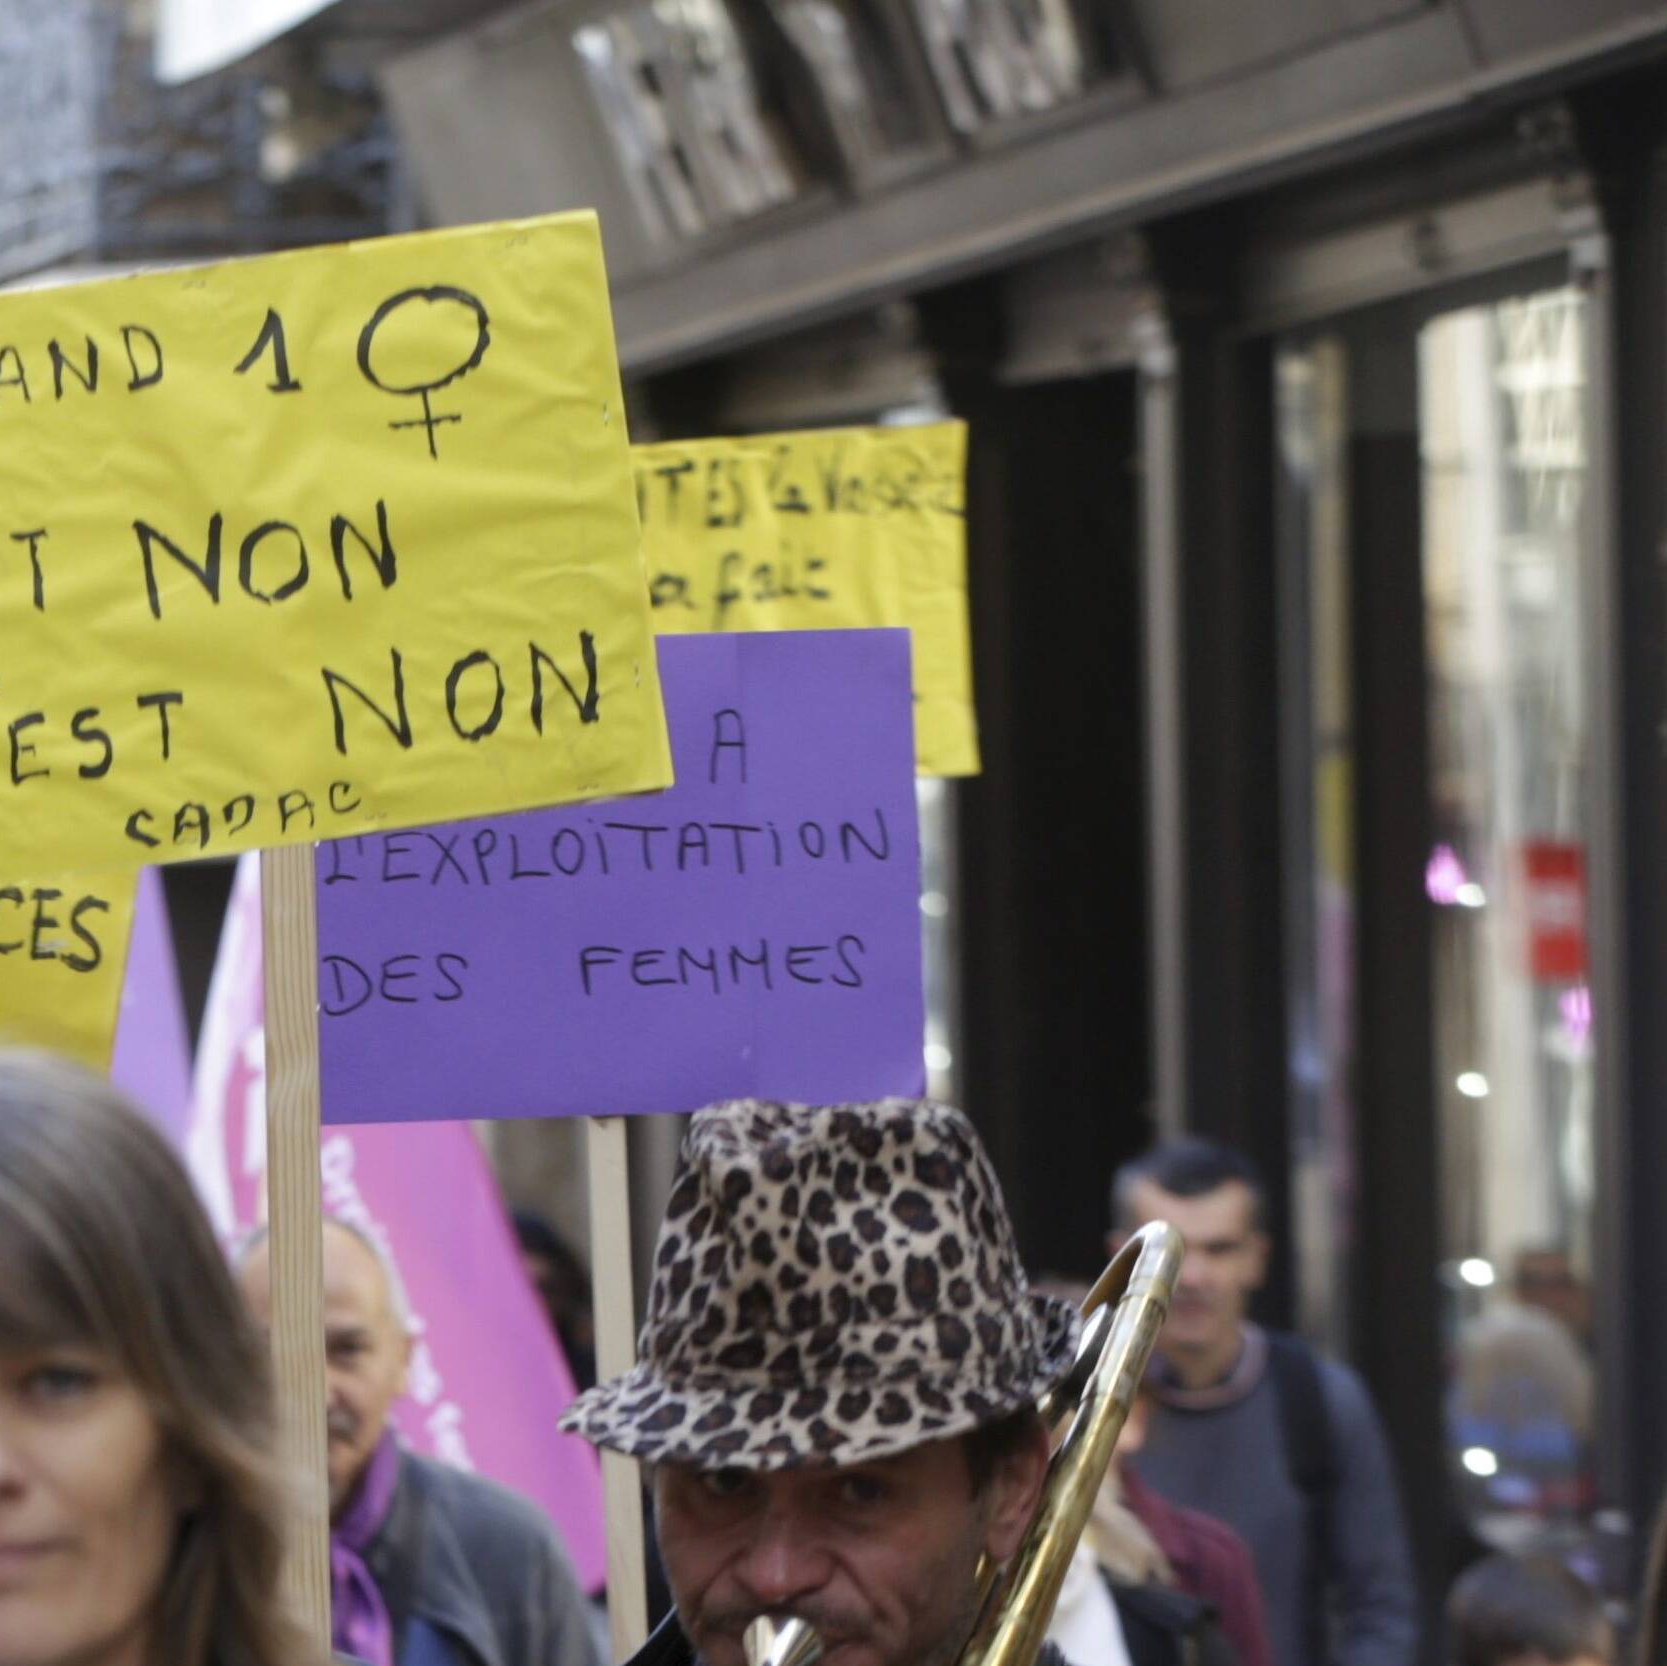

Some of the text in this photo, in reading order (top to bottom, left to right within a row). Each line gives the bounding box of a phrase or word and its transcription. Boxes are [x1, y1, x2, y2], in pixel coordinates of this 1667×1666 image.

[235, 308, 302, 391] 1
[132, 499, 398, 619] NON
[321, 630, 600, 755] NON
[125, 780, 362, 848] CADAC
[322, 933, 867, 1017] DES FEMMES
